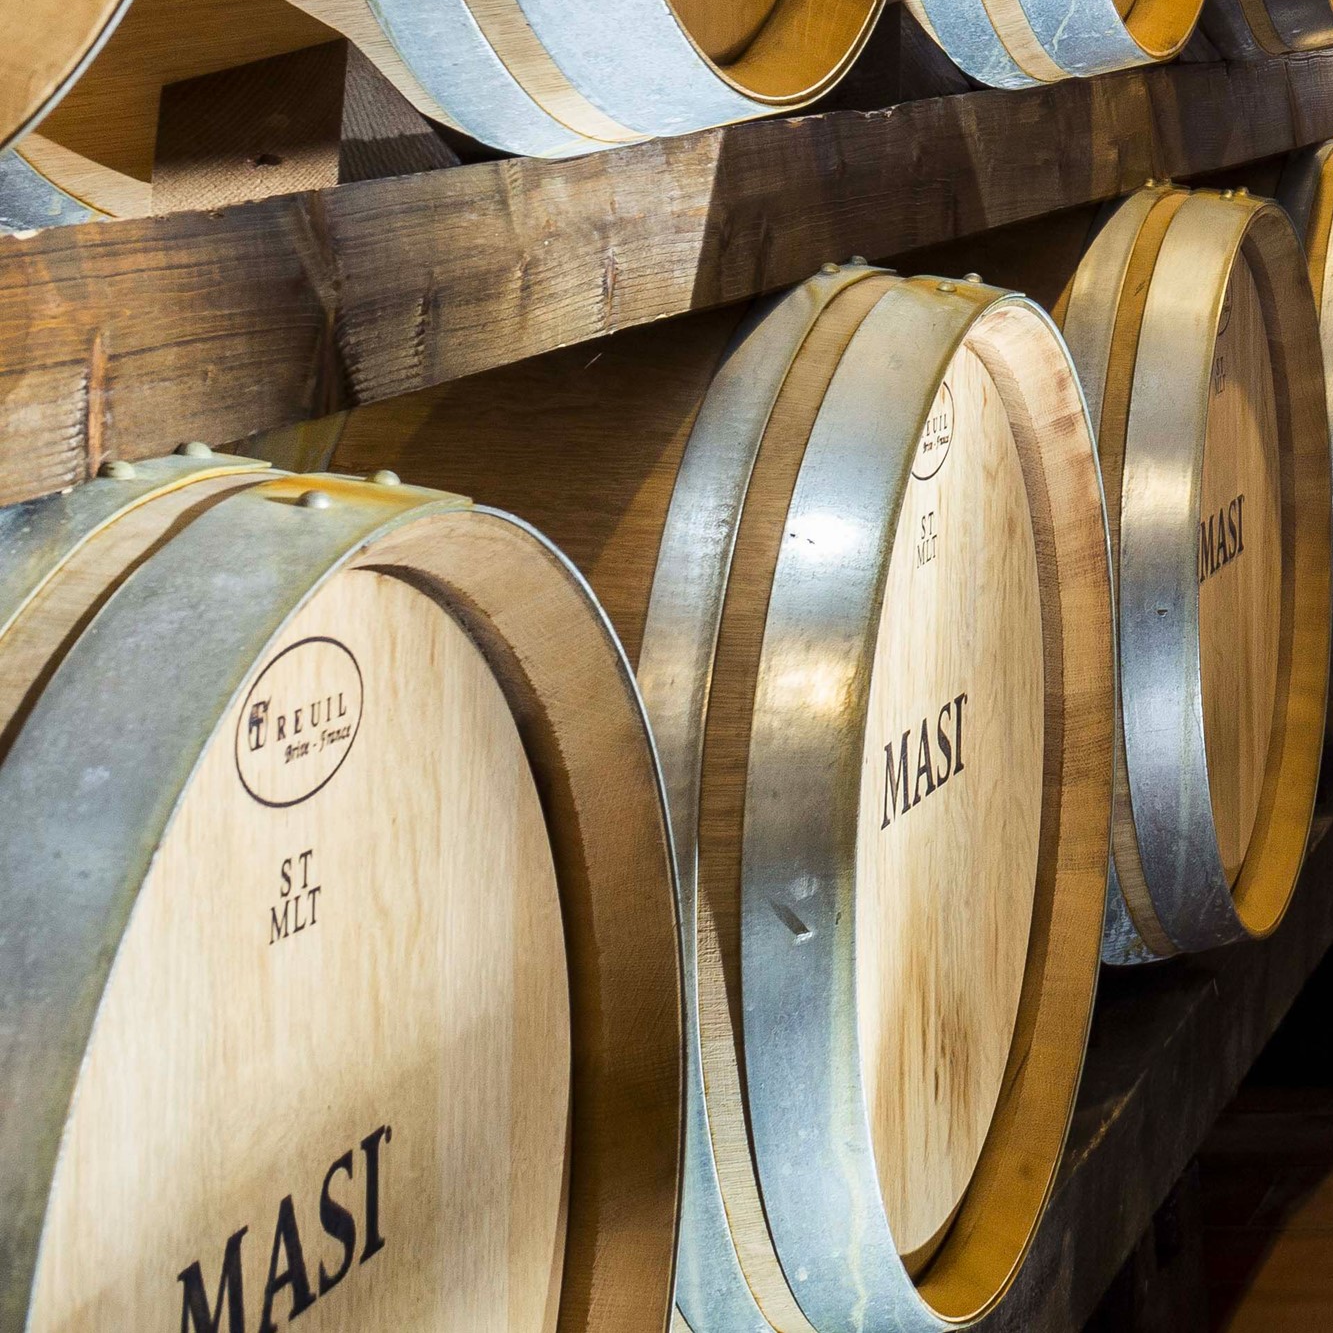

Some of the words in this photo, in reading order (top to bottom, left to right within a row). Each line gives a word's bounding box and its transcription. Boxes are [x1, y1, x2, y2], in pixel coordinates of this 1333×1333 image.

[917, 534, 938, 569] MLT
[1199, 494, 1245, 583] MASI
[881, 692, 968, 831] MASI
[269, 886, 321, 945] MLT
